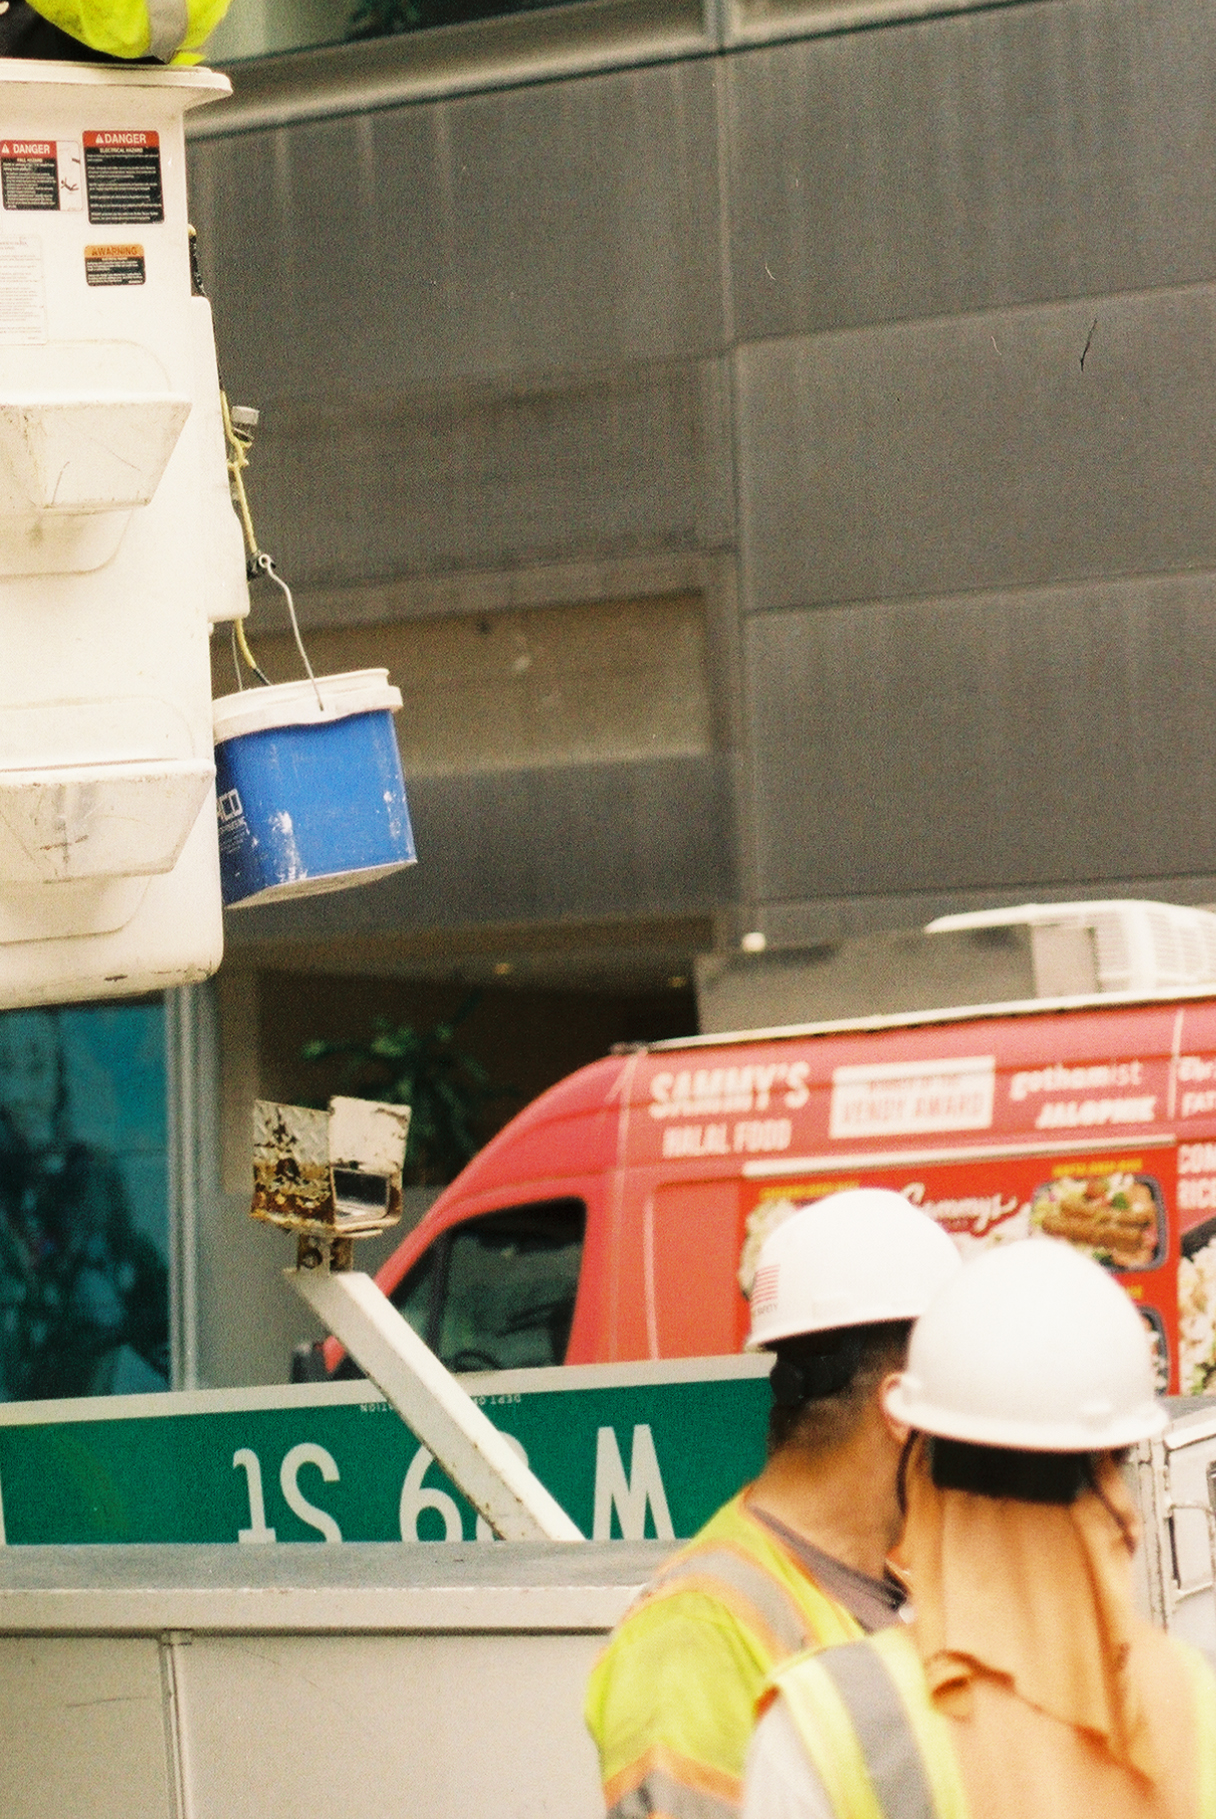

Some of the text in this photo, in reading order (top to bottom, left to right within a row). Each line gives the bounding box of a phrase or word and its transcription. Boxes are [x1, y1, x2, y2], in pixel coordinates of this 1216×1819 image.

[104, 133, 147, 144] DANGER
[12, 143, 51, 155] DANGER
[98, 246, 139, 257] WARNING
[648, 1061, 811, 1120] SAMMY'S
[231, 1441, 343, 1544] St
